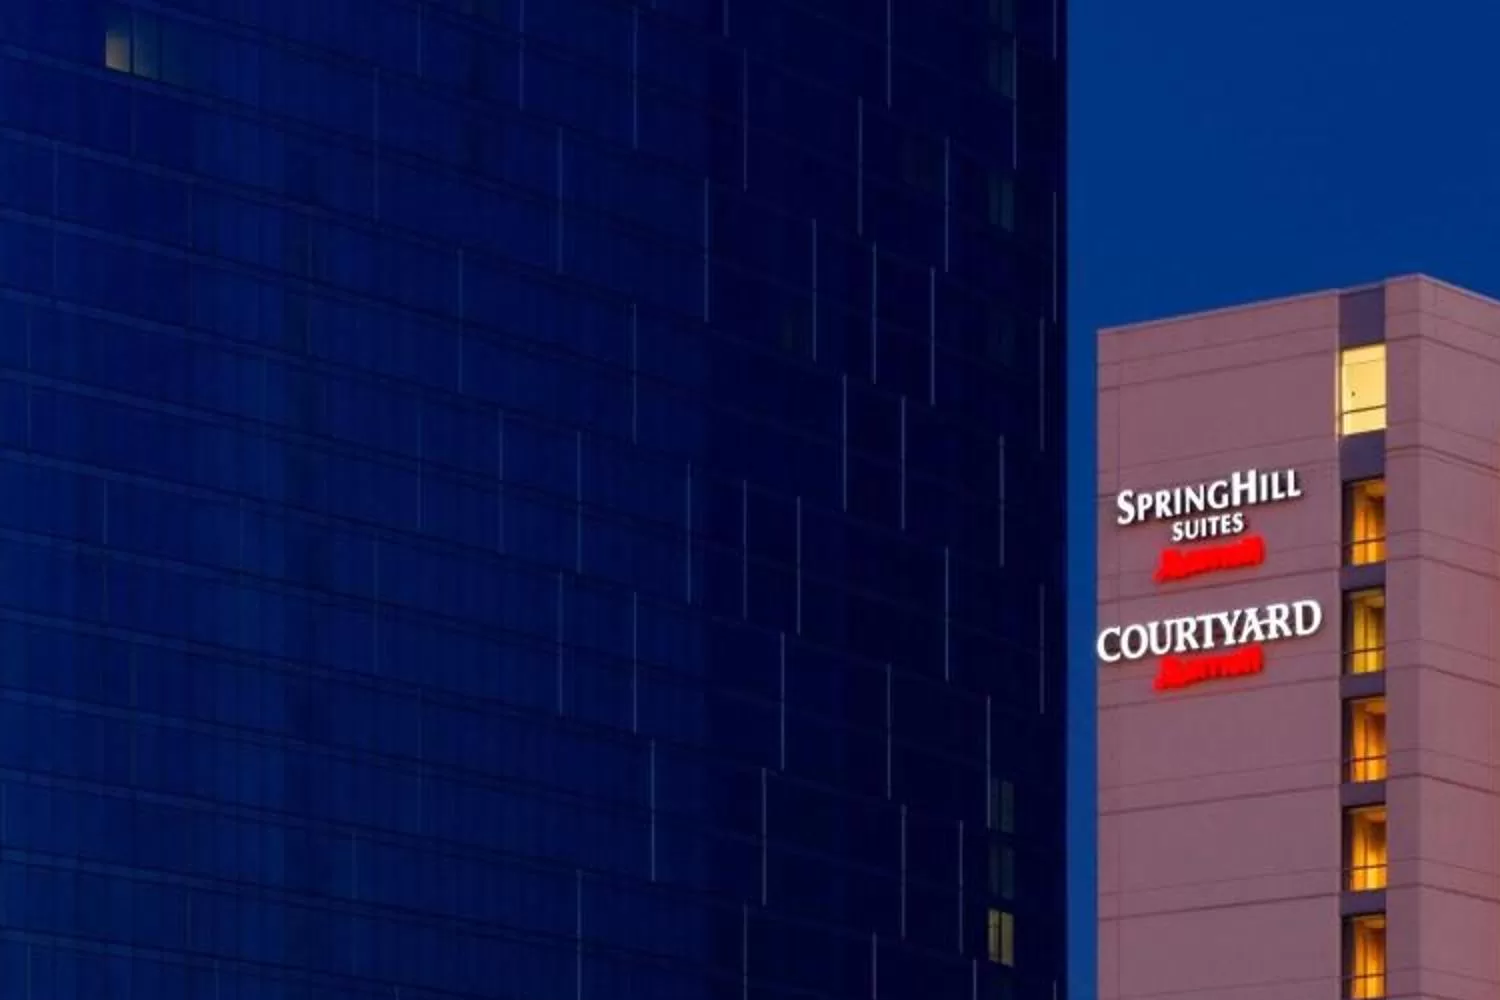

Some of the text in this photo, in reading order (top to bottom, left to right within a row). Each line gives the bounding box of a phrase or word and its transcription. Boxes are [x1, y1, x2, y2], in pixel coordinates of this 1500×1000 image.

[1116, 468, 1302, 526] SPRINGHILL
[1172, 512, 1245, 542] SUITES
[1096, 599, 1323, 663] COURTYARD
